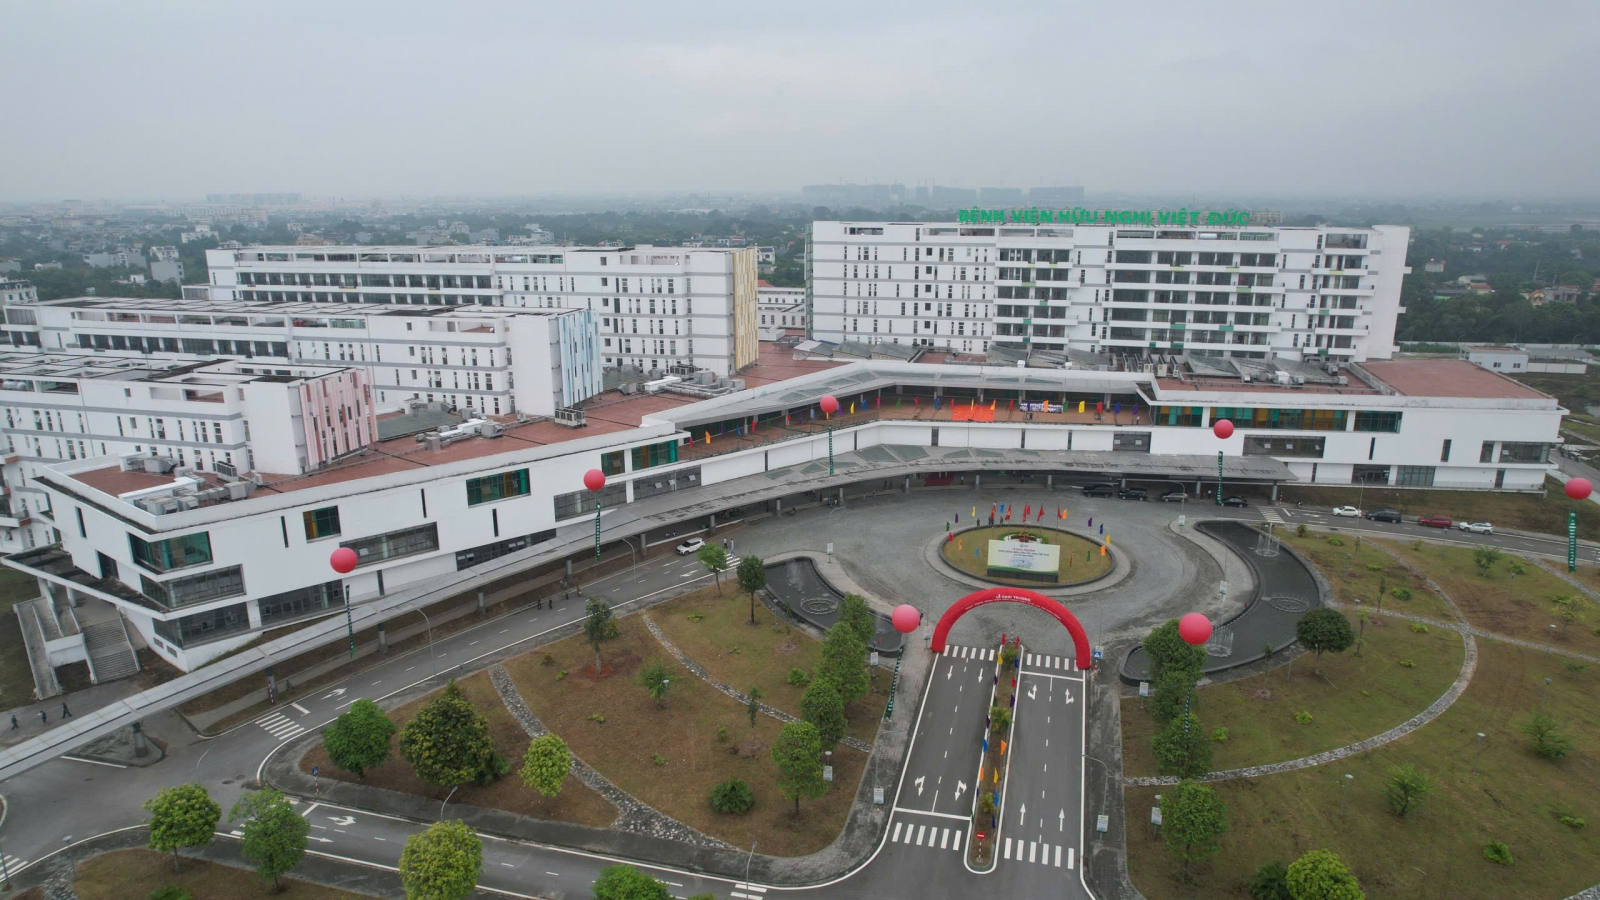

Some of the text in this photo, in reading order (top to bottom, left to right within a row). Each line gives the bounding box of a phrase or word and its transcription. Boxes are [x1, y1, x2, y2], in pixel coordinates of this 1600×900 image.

[959, 205, 1251, 228] BỆNH VIỆN HỮU NGHỊ VIỆT ĐỨC
